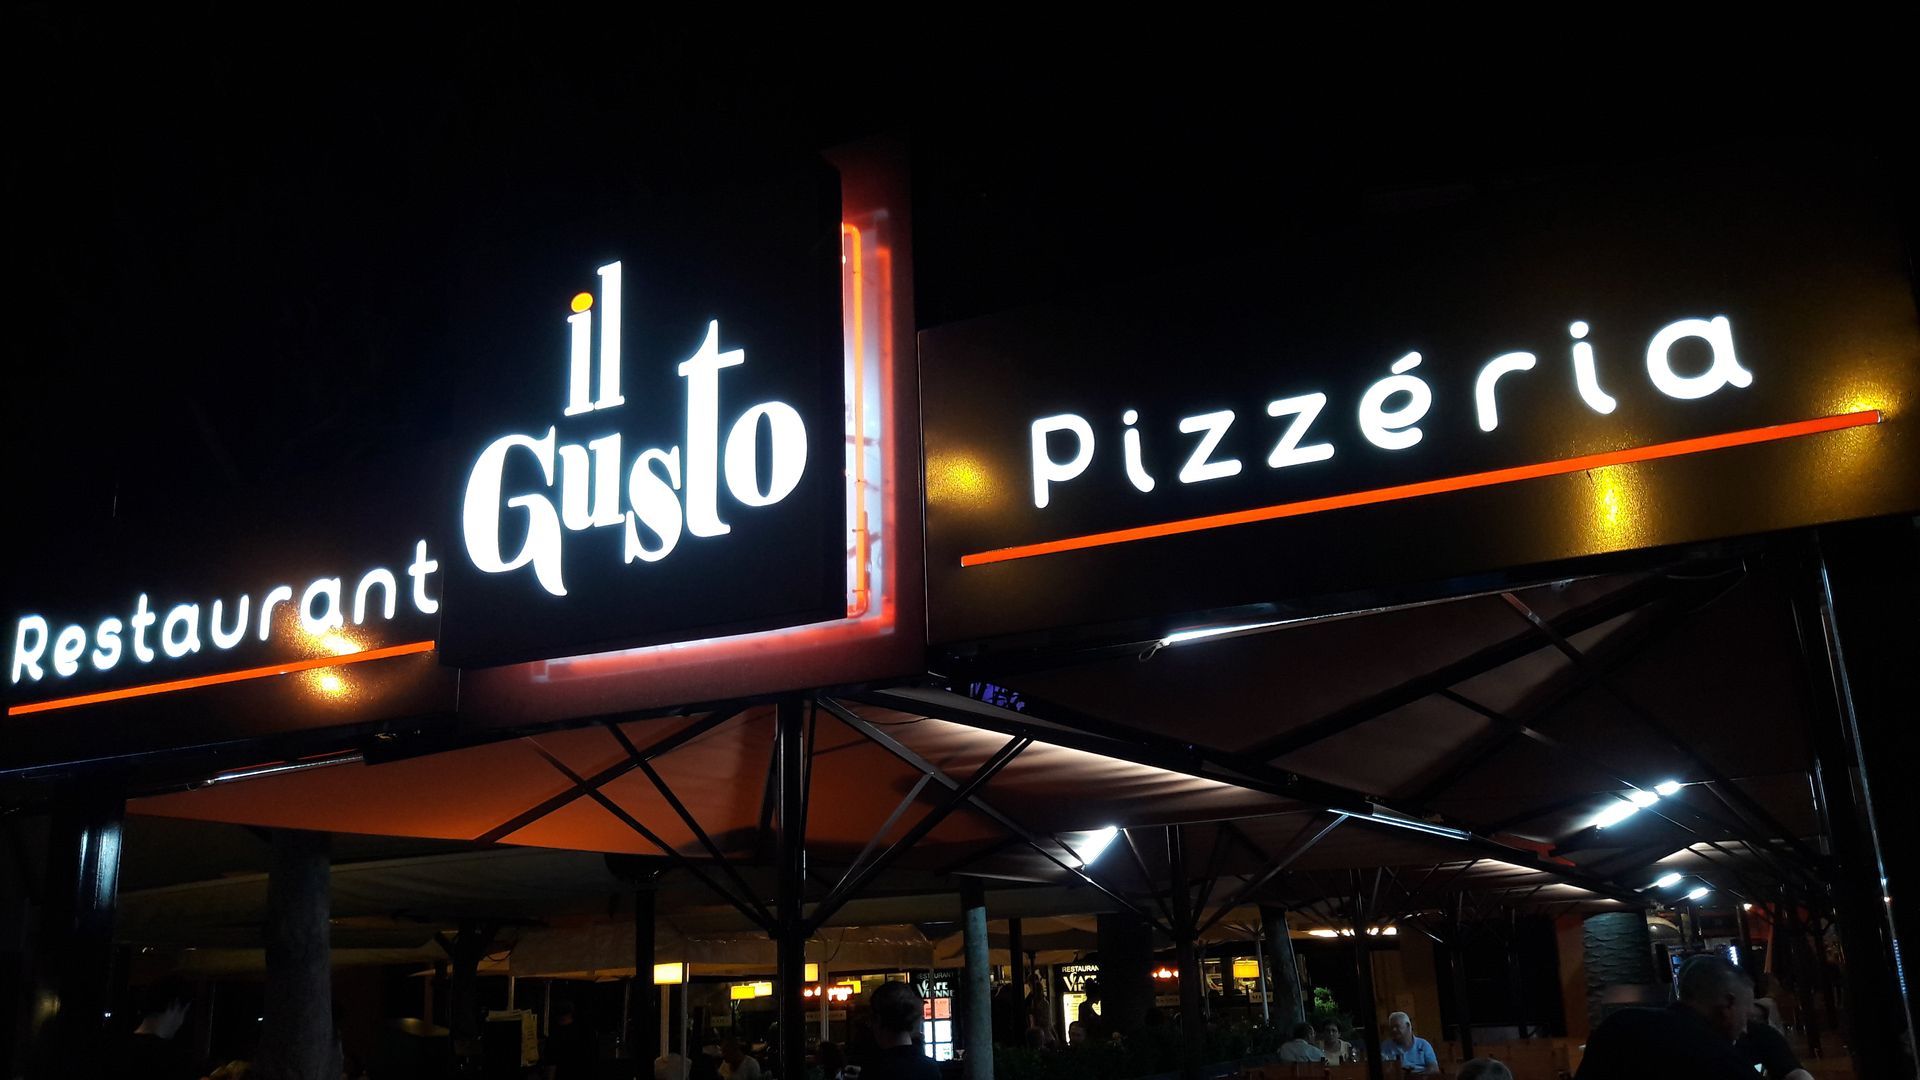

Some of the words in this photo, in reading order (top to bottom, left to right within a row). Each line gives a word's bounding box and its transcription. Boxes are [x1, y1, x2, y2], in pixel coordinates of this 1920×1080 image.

[563, 260, 625, 417] il
[1031, 315, 1753, 509] Pizzéria
[463, 319, 808, 597] Gusto
[10, 539, 439, 684] Restaurant
[1061, 965, 1099, 973] RESTAURAN
